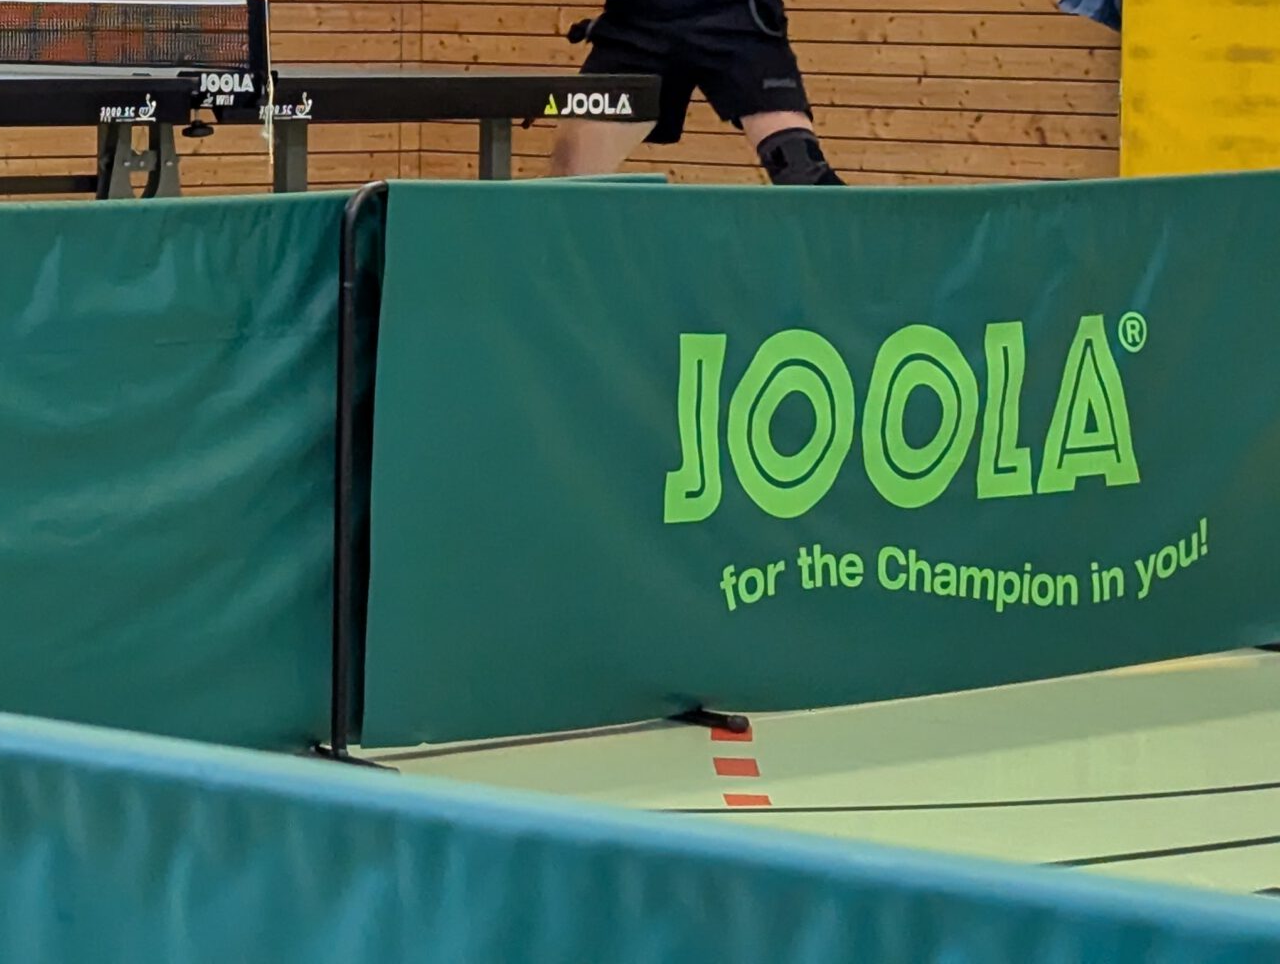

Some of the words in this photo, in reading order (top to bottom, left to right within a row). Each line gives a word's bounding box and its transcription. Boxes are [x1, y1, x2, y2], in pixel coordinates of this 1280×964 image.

[200, 73, 255, 93] JOOLA
[561, 92, 632, 115] JOOLA
[720, 560, 786, 612] for
[797, 543, 865, 590] the
[877, 545, 1079, 613] Champion
[1090, 561, 1125, 603] in
[1134, 517, 1209, 600] you!
